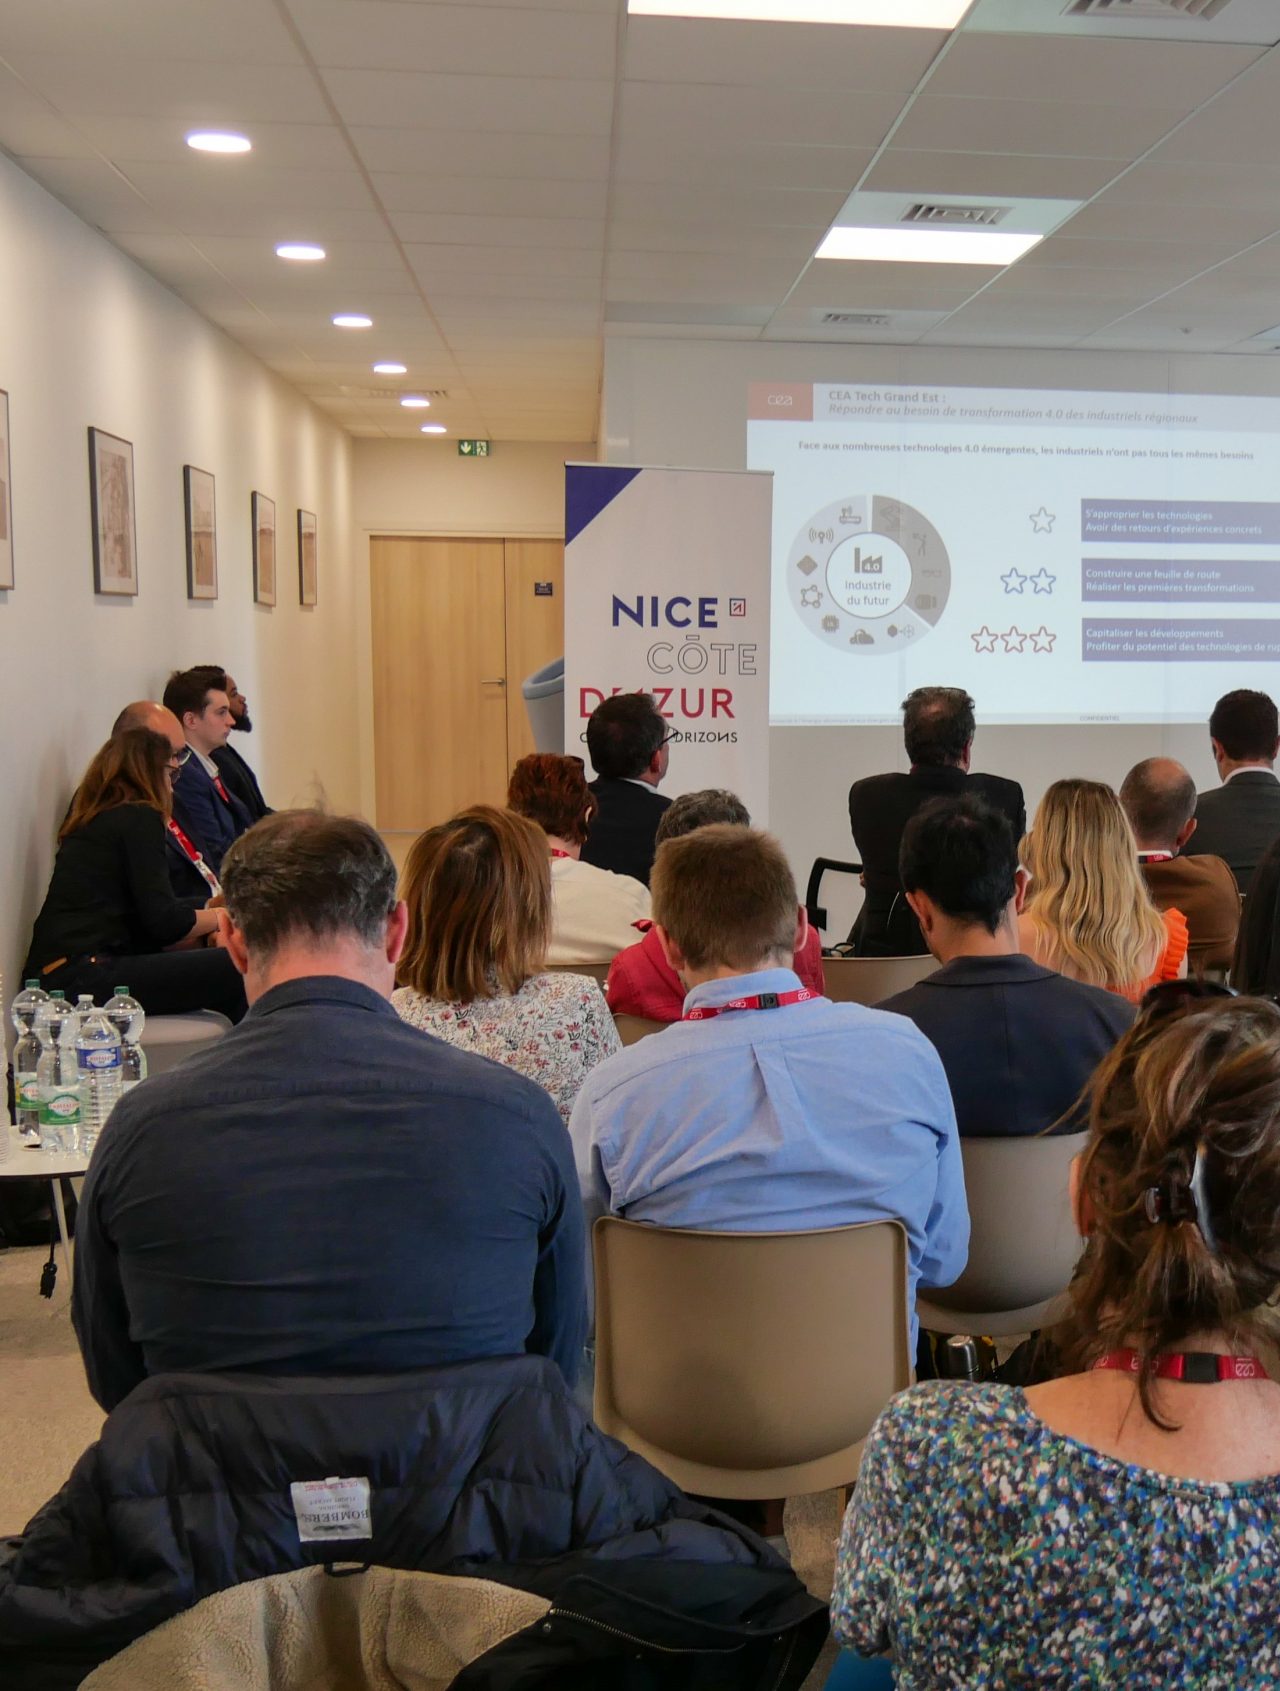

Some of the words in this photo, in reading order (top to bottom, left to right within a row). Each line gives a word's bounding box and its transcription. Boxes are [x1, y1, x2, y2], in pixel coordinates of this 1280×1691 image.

[768, 394, 793, 406] cea
[828, 391, 850, 401] CEA
[855, 391, 882, 402] Tech
[884, 392, 919, 403] Grand
[922, 393, 939, 403] Est
[828, 403, 883, 416] Répondre
[886, 407, 901, 416] au
[904, 405, 940, 417] besoin
[943, 406, 957, 417] de
[960, 406, 1043, 420] transformation
[1045, 409, 1064, 419] 4.0
[1066, 409, 1084, 420] des
[1086, 410, 1143, 422] industriels
[1145, 412, 1199, 425] régionaux
[799, 441, 820, 450] Face
[822, 442, 840, 451] aux
[842, 442, 901, 452] nombreuses
[903, 443, 962, 455] technologies
[964, 444, 980, 453] 4.0
[1041, 446, 1054, 455] les
[1056, 446, 1104, 457] industriels
[1131, 450, 1148, 460] pas
[1149, 449, 1169, 459] tous
[1171, 450, 1184, 459] les
[1186, 450, 1219, 460] mêmes
[1220, 451, 1254, 461] besoins
[1142, 510, 1155, 520] les
[1156, 511, 1213, 523] technologies
[1085, 523, 1110, 533] Avoir
[1111, 523, 1127, 533] des
[1129, 525, 1161, 534] retours
[1225, 526, 1263, 535] concrets
[864, 562, 880, 572] 4.0
[1086, 569, 1133, 579] Construire
[1134, 571, 1152, 579] une
[1154, 570, 1182, 579] feuille
[1183, 570, 1195, 579] de
[1197, 571, 1221, 579] route
[1086, 582, 1121, 592] Réaliser
[1123, 582, 1137, 592] les
[1138, 583, 1183, 595] premières
[1185, 583, 1255, 593] transformations
[847, 595, 860, 605] du
[863, 595, 890, 606] futur
[612, 594, 718, 628] NICE
[1086, 628, 1134, 640] Capitaliser
[1135, 629, 1148, 638] les
[1150, 628, 1224, 641] développements
[1086, 642, 1121, 651] Profiter
[1122, 642, 1135, 651] du
[1136, 642, 1177, 653] potentiel
[1179, 642, 1195, 651] des
[1196, 642, 1252, 654] technologies
[1254, 643, 1266, 652] de
